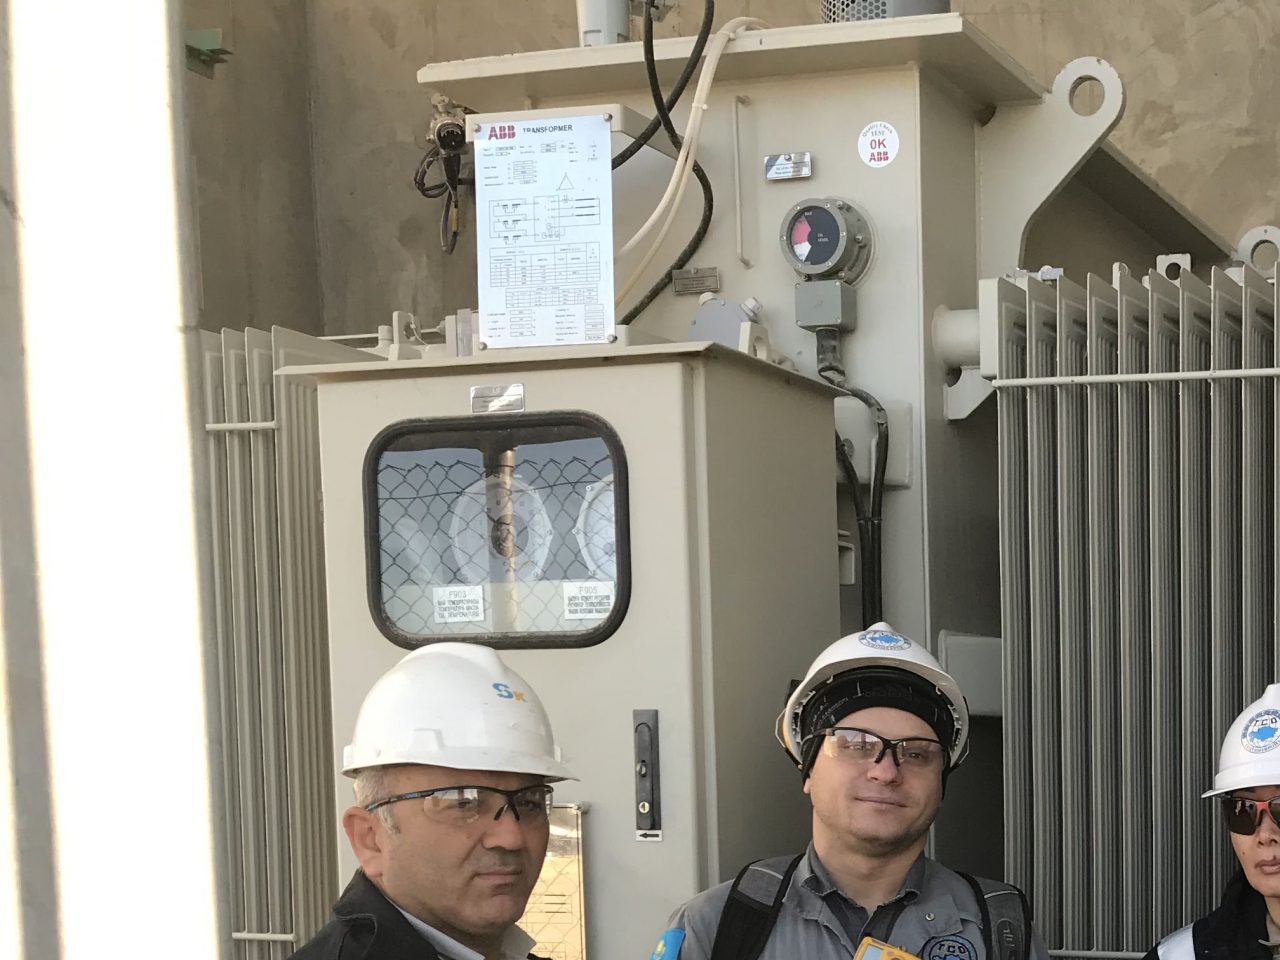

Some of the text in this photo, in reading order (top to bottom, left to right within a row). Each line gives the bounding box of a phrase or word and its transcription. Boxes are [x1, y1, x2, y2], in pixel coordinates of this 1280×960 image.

[488, 125, 516, 140] ABB
[522, 124, 573, 134] TRANSFORMER
[870, 138, 888, 150] OK
[869, 151, 889, 163] ABB
[448, 590, 467, 599] F903
[1253, 717, 1277, 727] TCO
[938, 943, 966, 954] TCO
